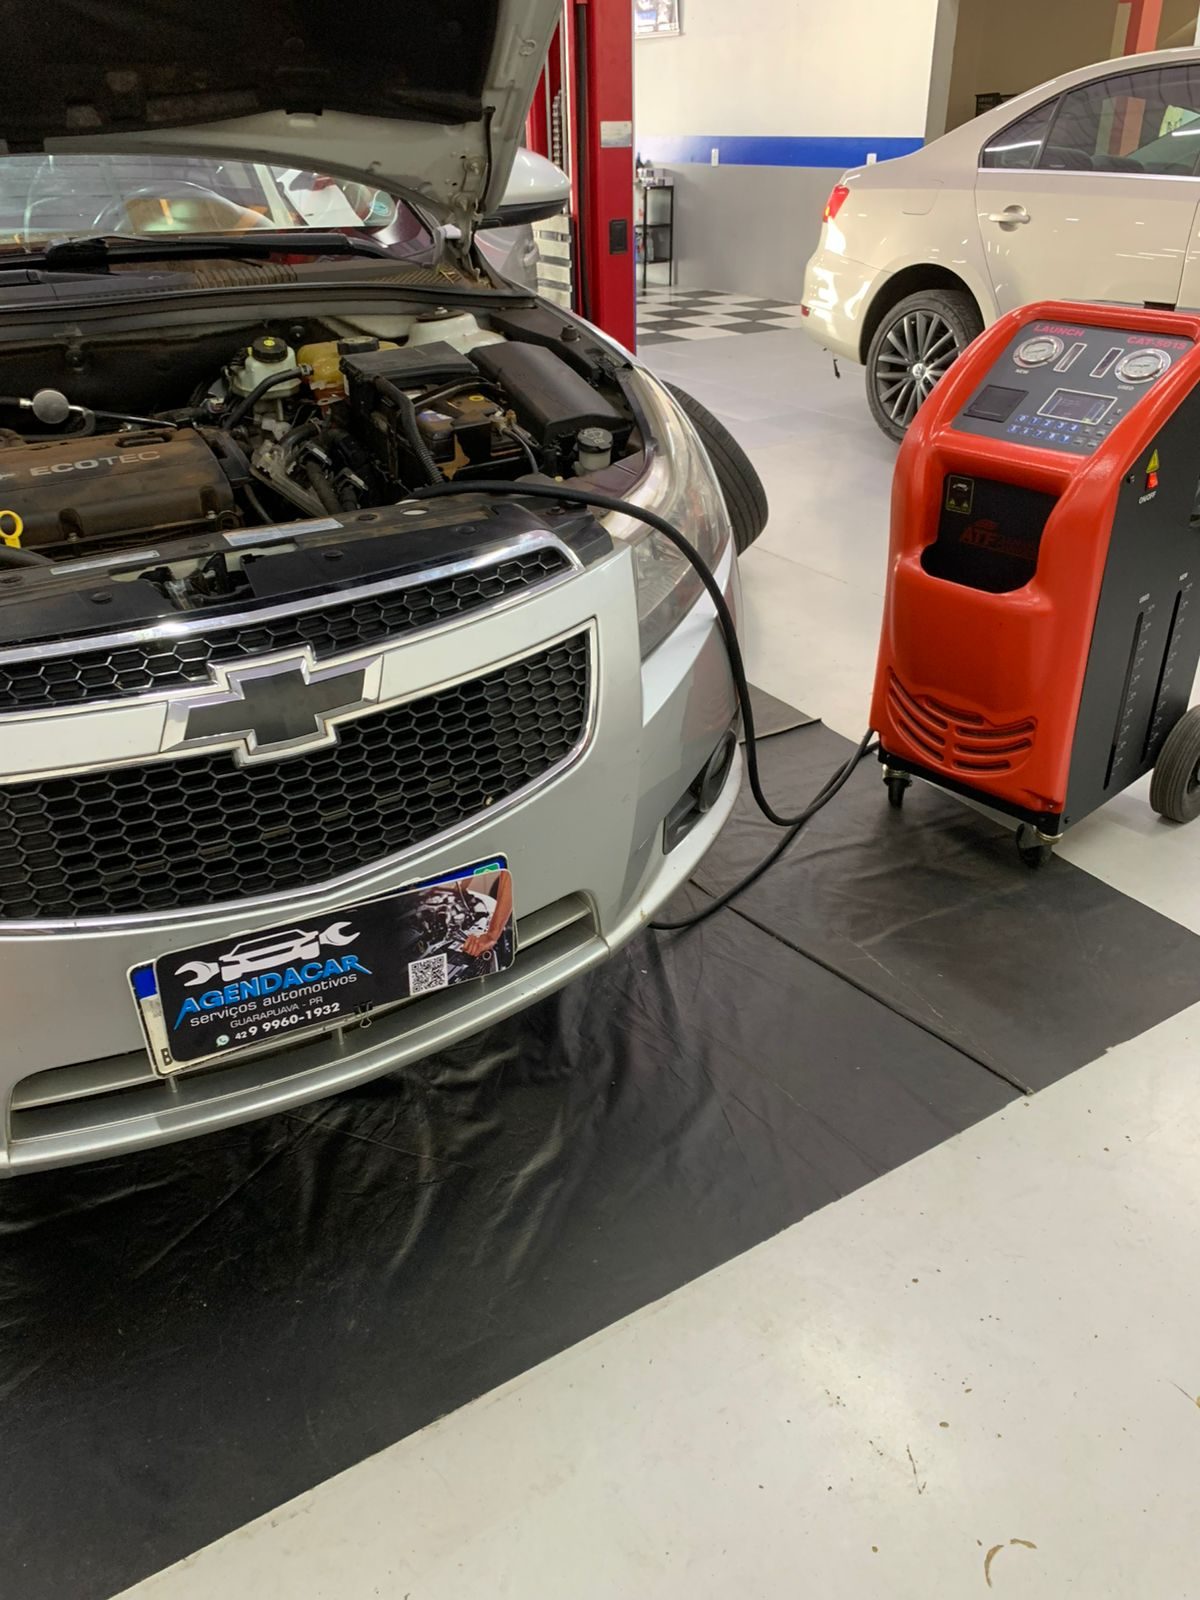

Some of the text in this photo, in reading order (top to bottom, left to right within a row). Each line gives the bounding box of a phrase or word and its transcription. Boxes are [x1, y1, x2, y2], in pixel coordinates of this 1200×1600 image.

[1033, 325, 1085, 337] LAUNCH
[30, 450, 160, 477] ECOTEC
[174, 954, 372, 1031] AGENDACAR
[190, 973, 358, 1027] serviços automotivos
[230, 1002, 300, 1028] GUARAPUAVA
[309, 996, 323, 1007] PR
[262, 1002, 341, 1032] 9960-1932
